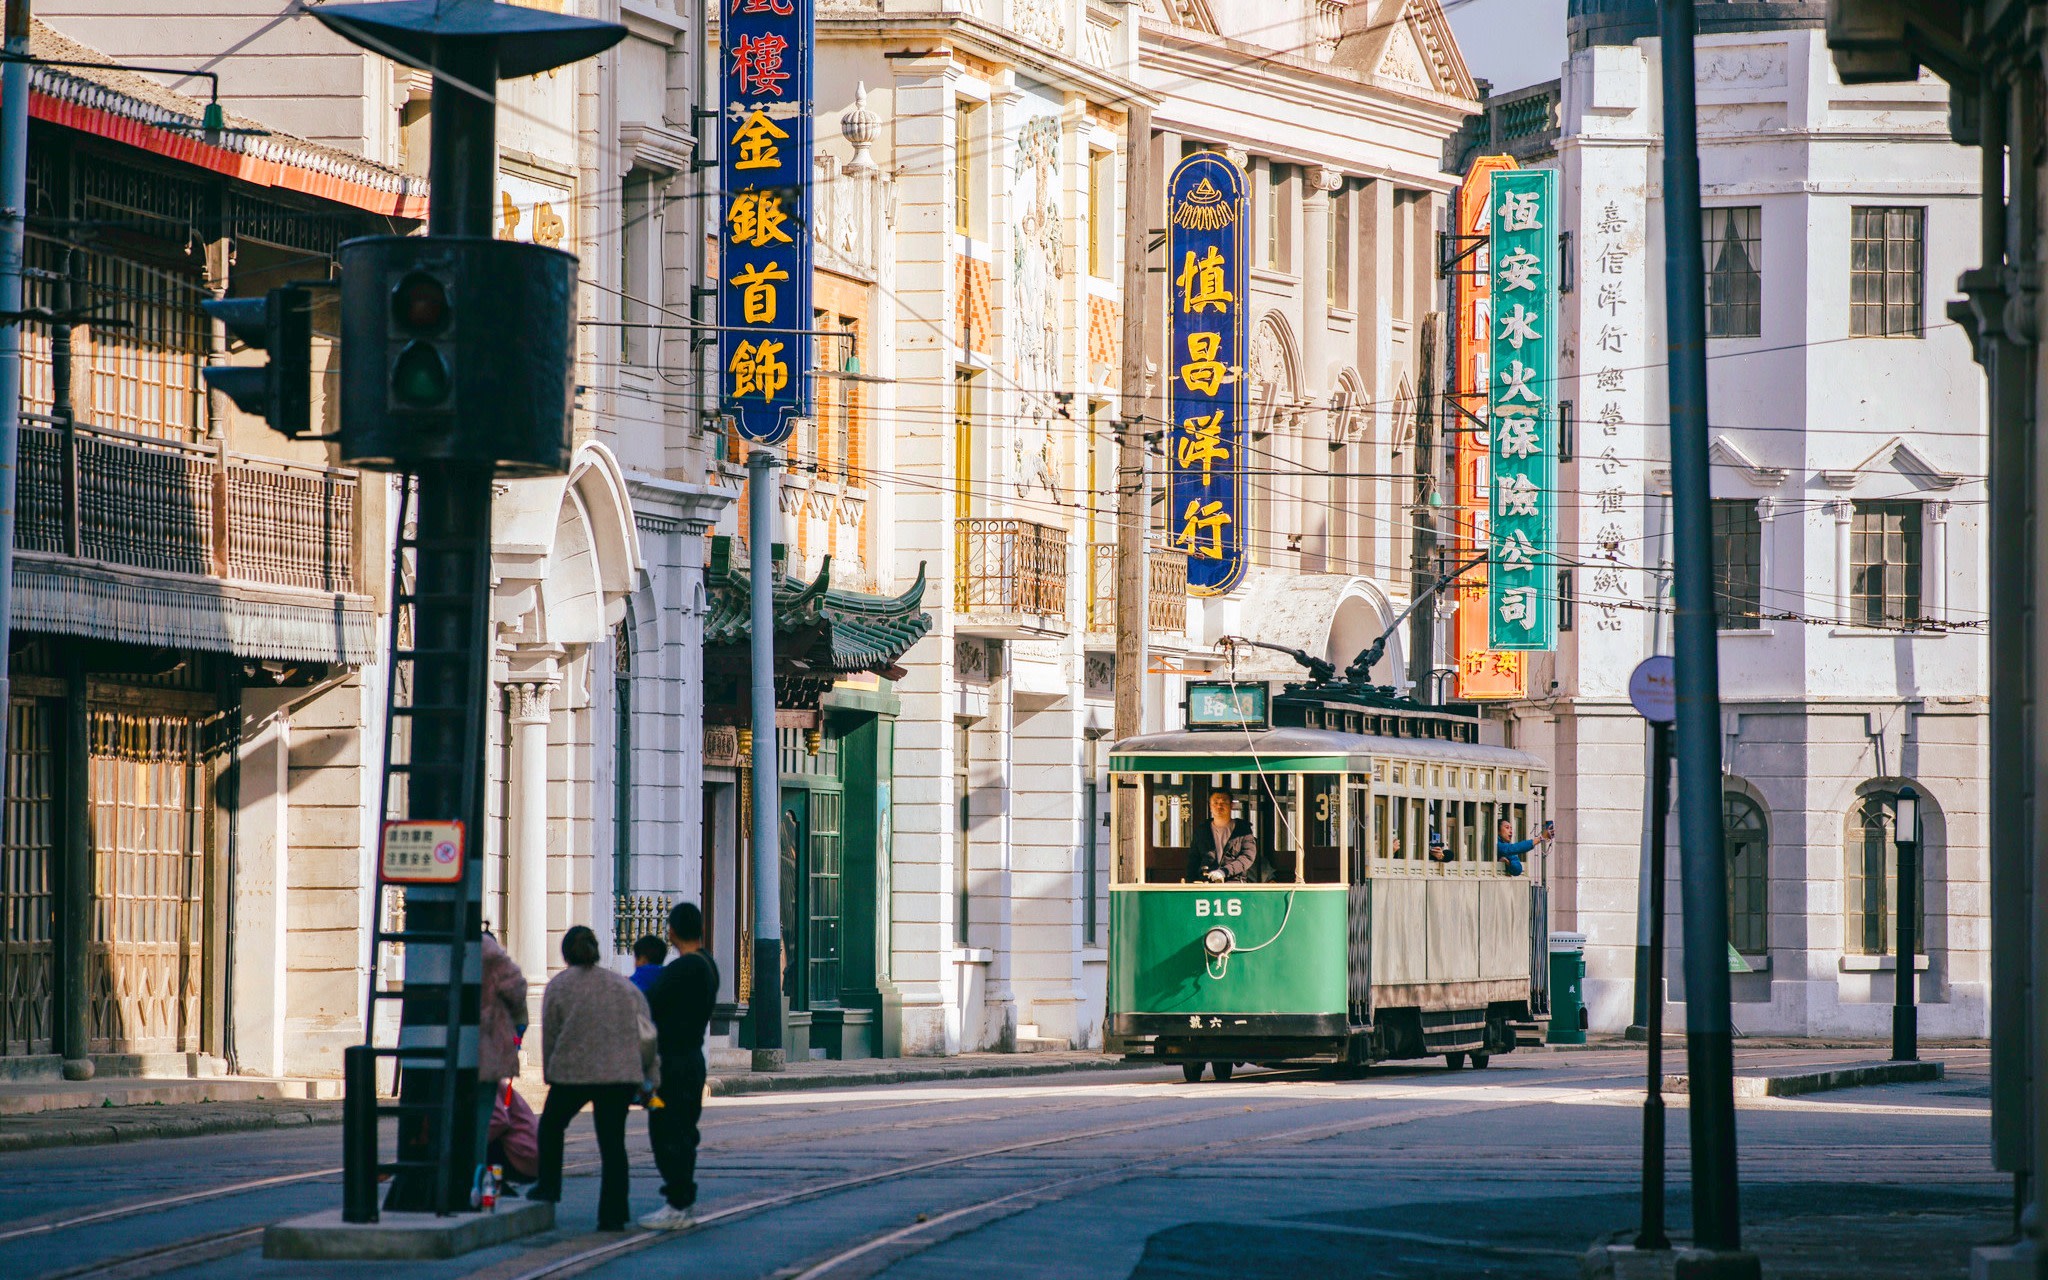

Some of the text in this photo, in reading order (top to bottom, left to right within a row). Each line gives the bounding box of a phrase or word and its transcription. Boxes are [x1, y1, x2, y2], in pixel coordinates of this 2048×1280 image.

[729, 0, 794, 404] 樓金銀首飾
[1176, 245, 1234, 561] 慎昌洋行
[1196, 899, 1242, 916] B16
